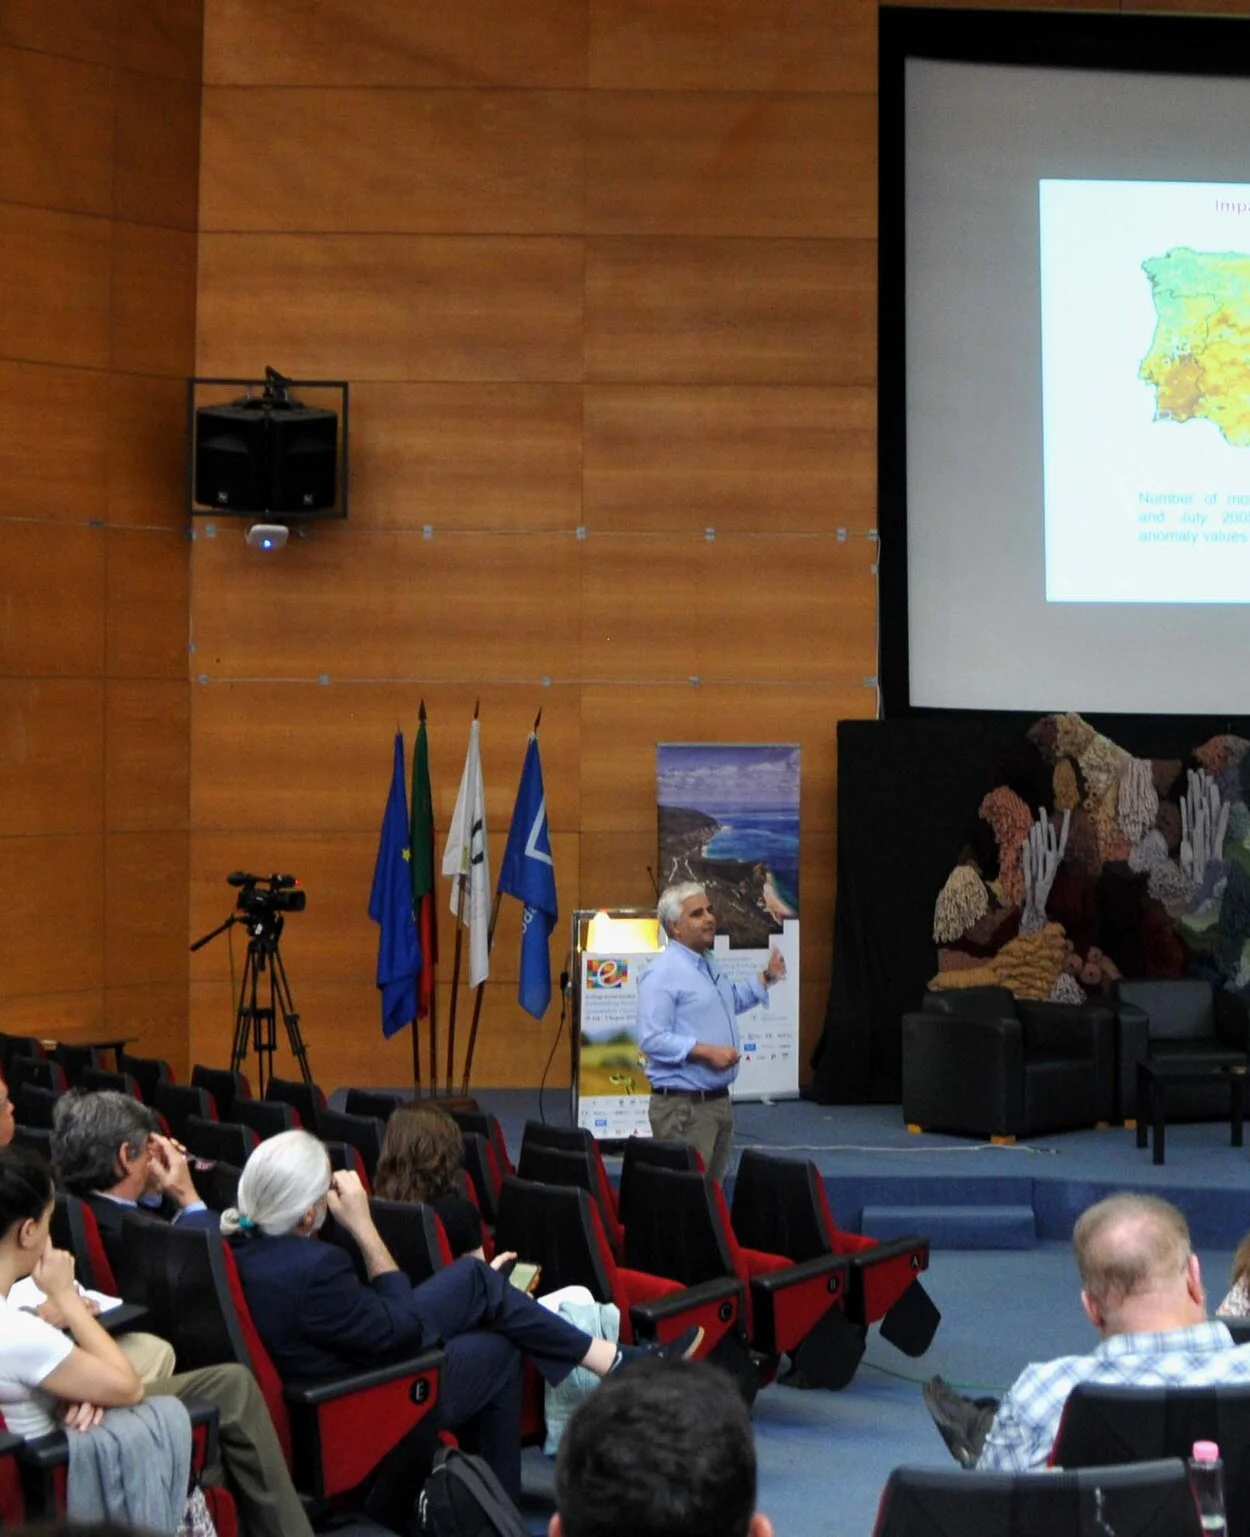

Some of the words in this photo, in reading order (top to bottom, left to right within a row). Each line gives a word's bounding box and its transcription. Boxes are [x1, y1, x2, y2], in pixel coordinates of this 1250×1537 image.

[1139, 492, 1192, 504] Number
[1205, 493, 1217, 505] of
[1139, 511, 1165, 523] and
[1181, 511, 1207, 526] July
[1139, 531, 1198, 545] anomaly
[1203, 531, 1247, 543] values
[416, 1380, 425, 1400] E
